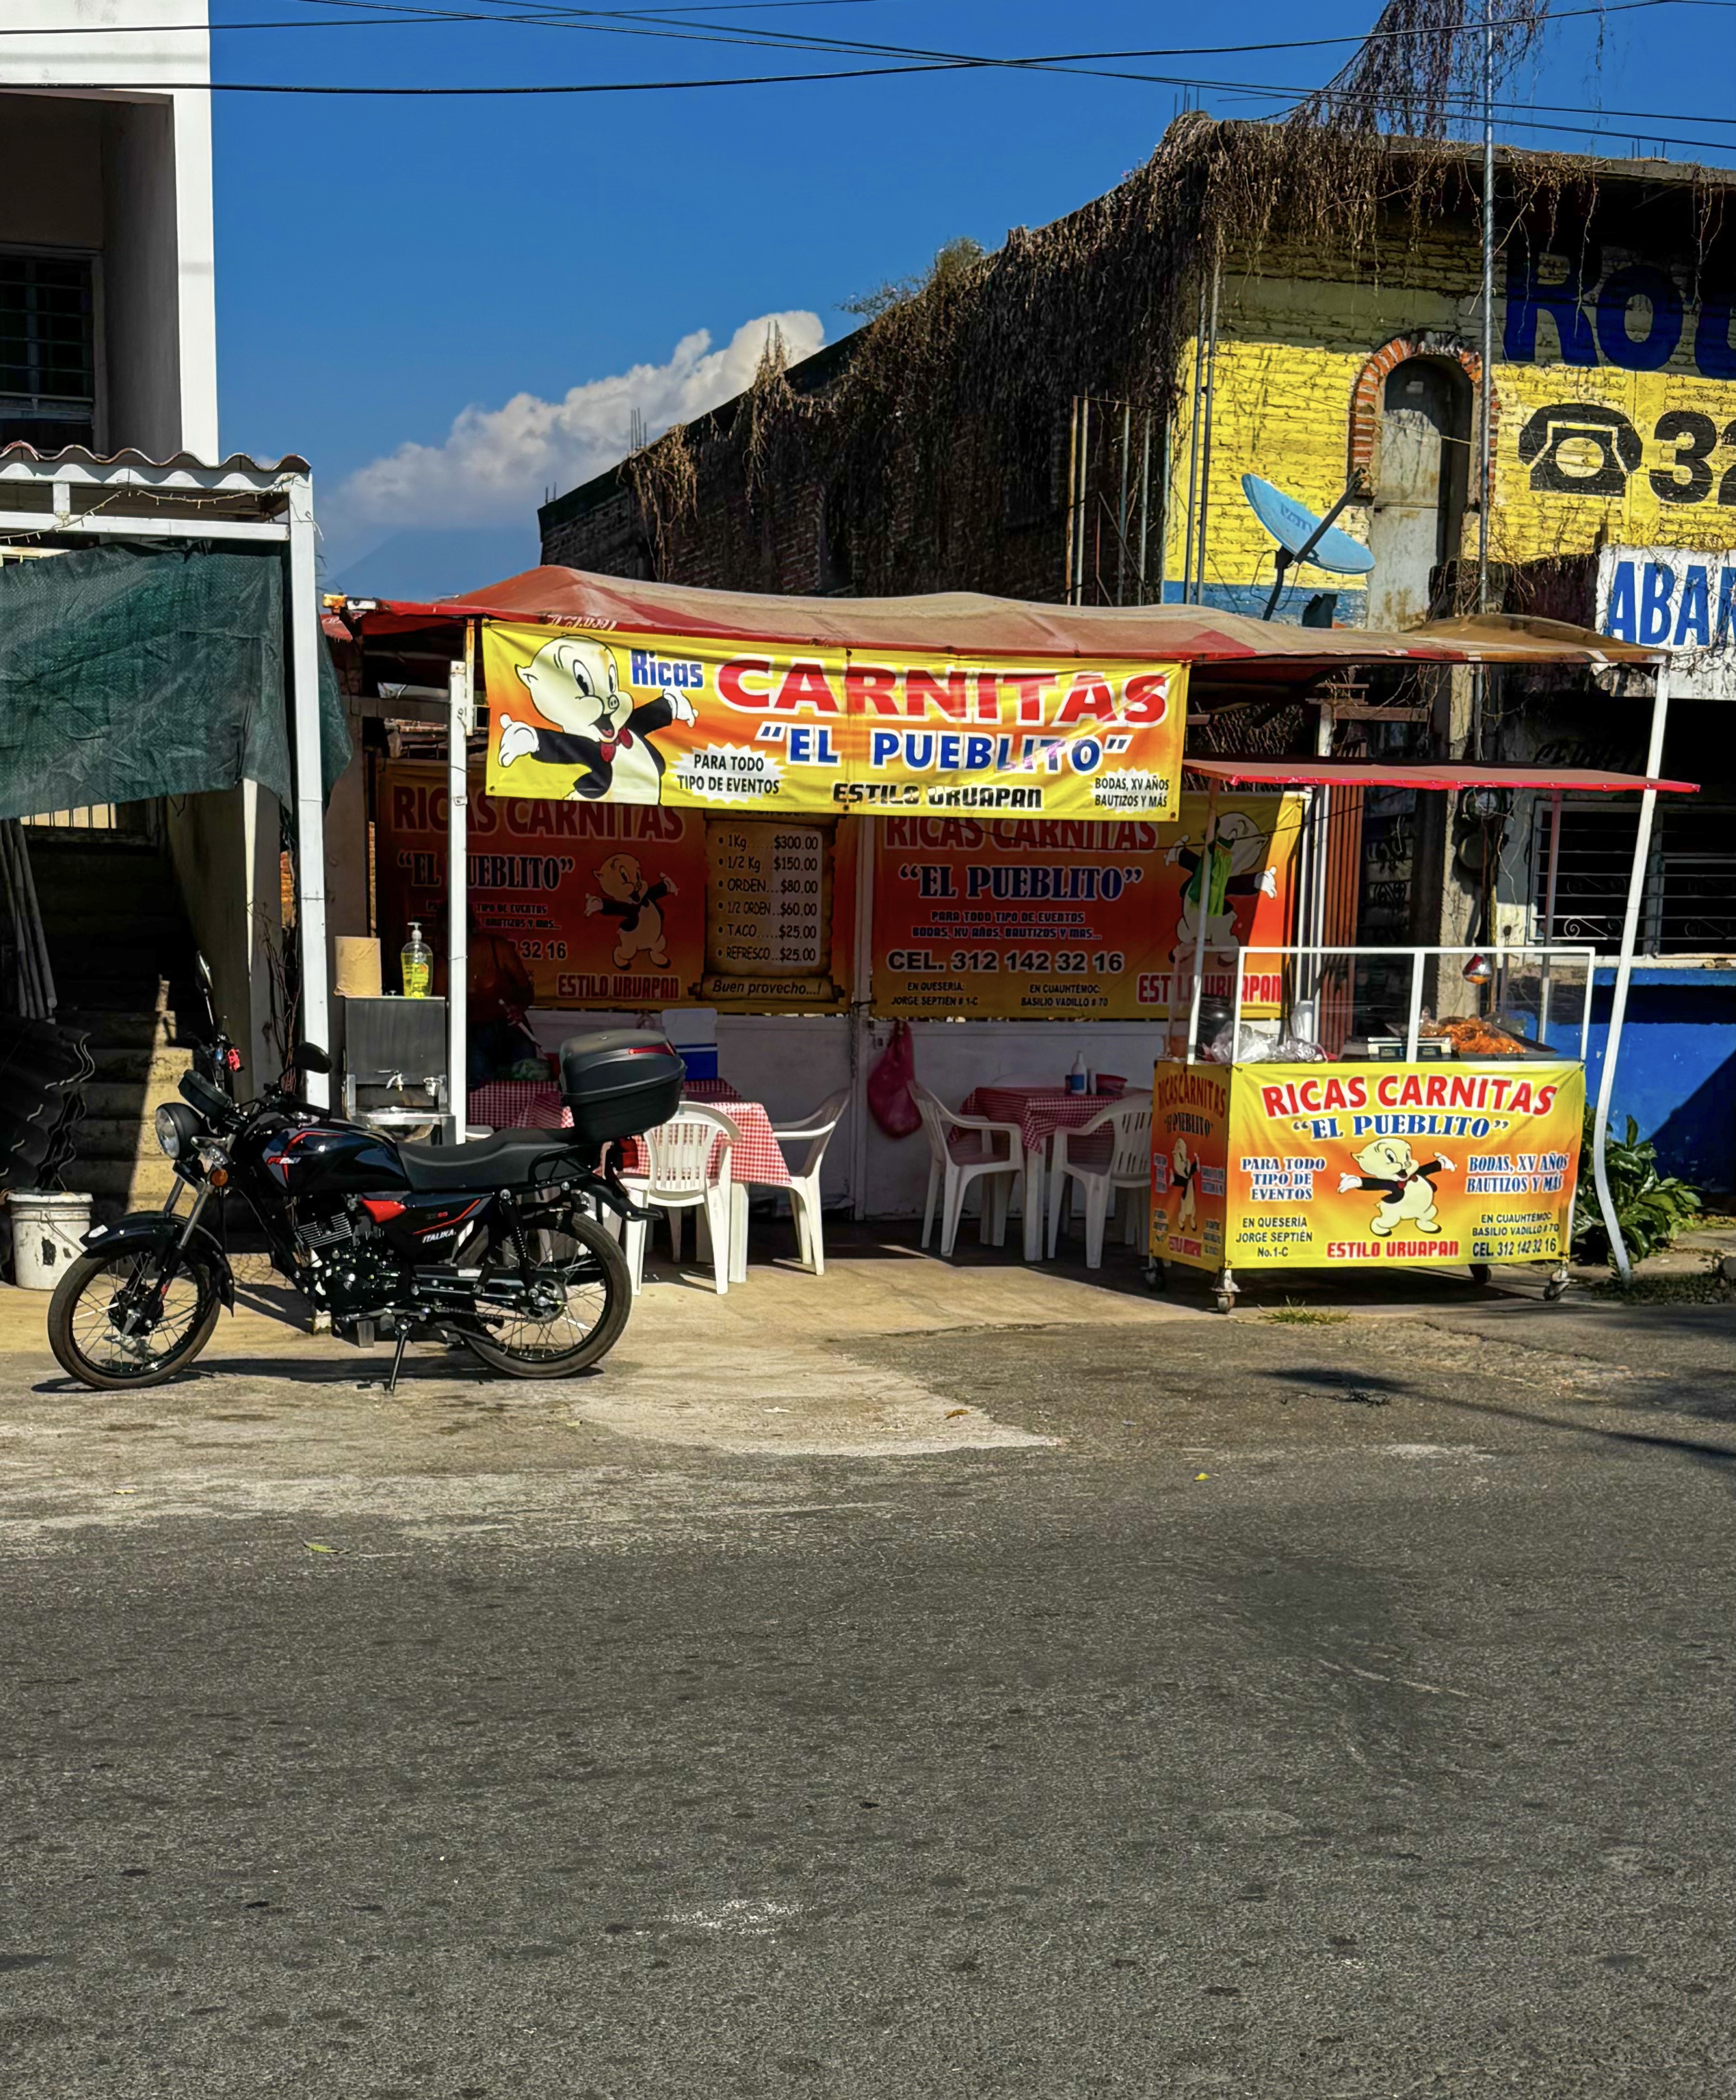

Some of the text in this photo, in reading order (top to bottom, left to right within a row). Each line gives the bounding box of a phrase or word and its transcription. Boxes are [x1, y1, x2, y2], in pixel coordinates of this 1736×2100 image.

[632, 650, 703, 688] Ricas
[718, 659, 1169, 724] CARNITAS
[694, 754, 764, 772] PARA TODO
[677, 774, 780, 795] TIPO DE EVENTOS
[1095, 775, 1170, 791] BODAS, XV AÑOS
[833, 783, 1042, 809] ESTILO URUAPAN
[1095, 793, 1167, 808] BAUTIZOS Y MÁS
[506, 798, 684, 840] CARNITAS
[886, 816, 1156, 850] RICAS CARNITAS
[774, 836, 818, 850] $300.00
[728, 856, 817, 872] 1/2 Kg $150.00
[468, 855, 573, 890] EBLITO”
[781, 880, 818, 894] $80.00
[728, 901, 741, 914] 1/2
[780, 903, 817, 916] $60.00
[932, 911, 1084, 923] PARA TODO TIPO DE EVENTOS
[779, 925, 816, 939] $25.00
[913, 927, 950, 937] BODAS,
[1005, 928, 1057, 937] BAUTIZOS
[1060, 929, 1066, 937] Y
[522, 941, 542, 958] 32
[547, 942, 566, 959] 16
[780, 947, 816, 962] $25.00
[888, 951, 1122, 972] CEL. 312 142 32 16
[558, 976, 678, 999] ESTILO URUAPAN
[712, 980, 744, 993] Buen
[907, 982, 919, 991] EN
[1029, 984, 1040, 993] EN
[893, 996, 918, 1006] JORGE
[1021, 997, 1053, 1007] BASILIO
[1055, 998, 1090, 1007] VADILLO
[1099, 998, 1108, 1007] 70
[1261, 1074, 1557, 1118] RICAS CARNITAS
[1242, 1158, 1325, 1170] PARA TODO
[1469, 1155, 1514, 1172] BODAS,
[1519, 1155, 1536, 1171] XV
[1253, 1173, 1312, 1185] TIPO DE
[1467, 1177, 1528, 1193] BAUTIZOS
[1533, 1177, 1541, 1192] Y
[1251, 1188, 1312, 1200] EVENTOS
[1243, 1215, 1308, 1228] EN QUESERÍA
[1481, 1214, 1494, 1223] EN
[422, 1229, 455, 1244] ITALIKA
[1236, 1229, 1313, 1243] JORGE SEPTIÉN
[1472, 1227, 1508, 1237] BASILIO
[1510, 1225, 1542, 1236] VADILLO
[1549, 1223, 1560, 1232] 70
[1327, 1240, 1460, 1258] ESTILO URUAPAN
[1473, 1242, 1494, 1257] CEL.
[1497, 1241, 1515, 1257] 312
[1544, 1238, 1556, 1252] 16
